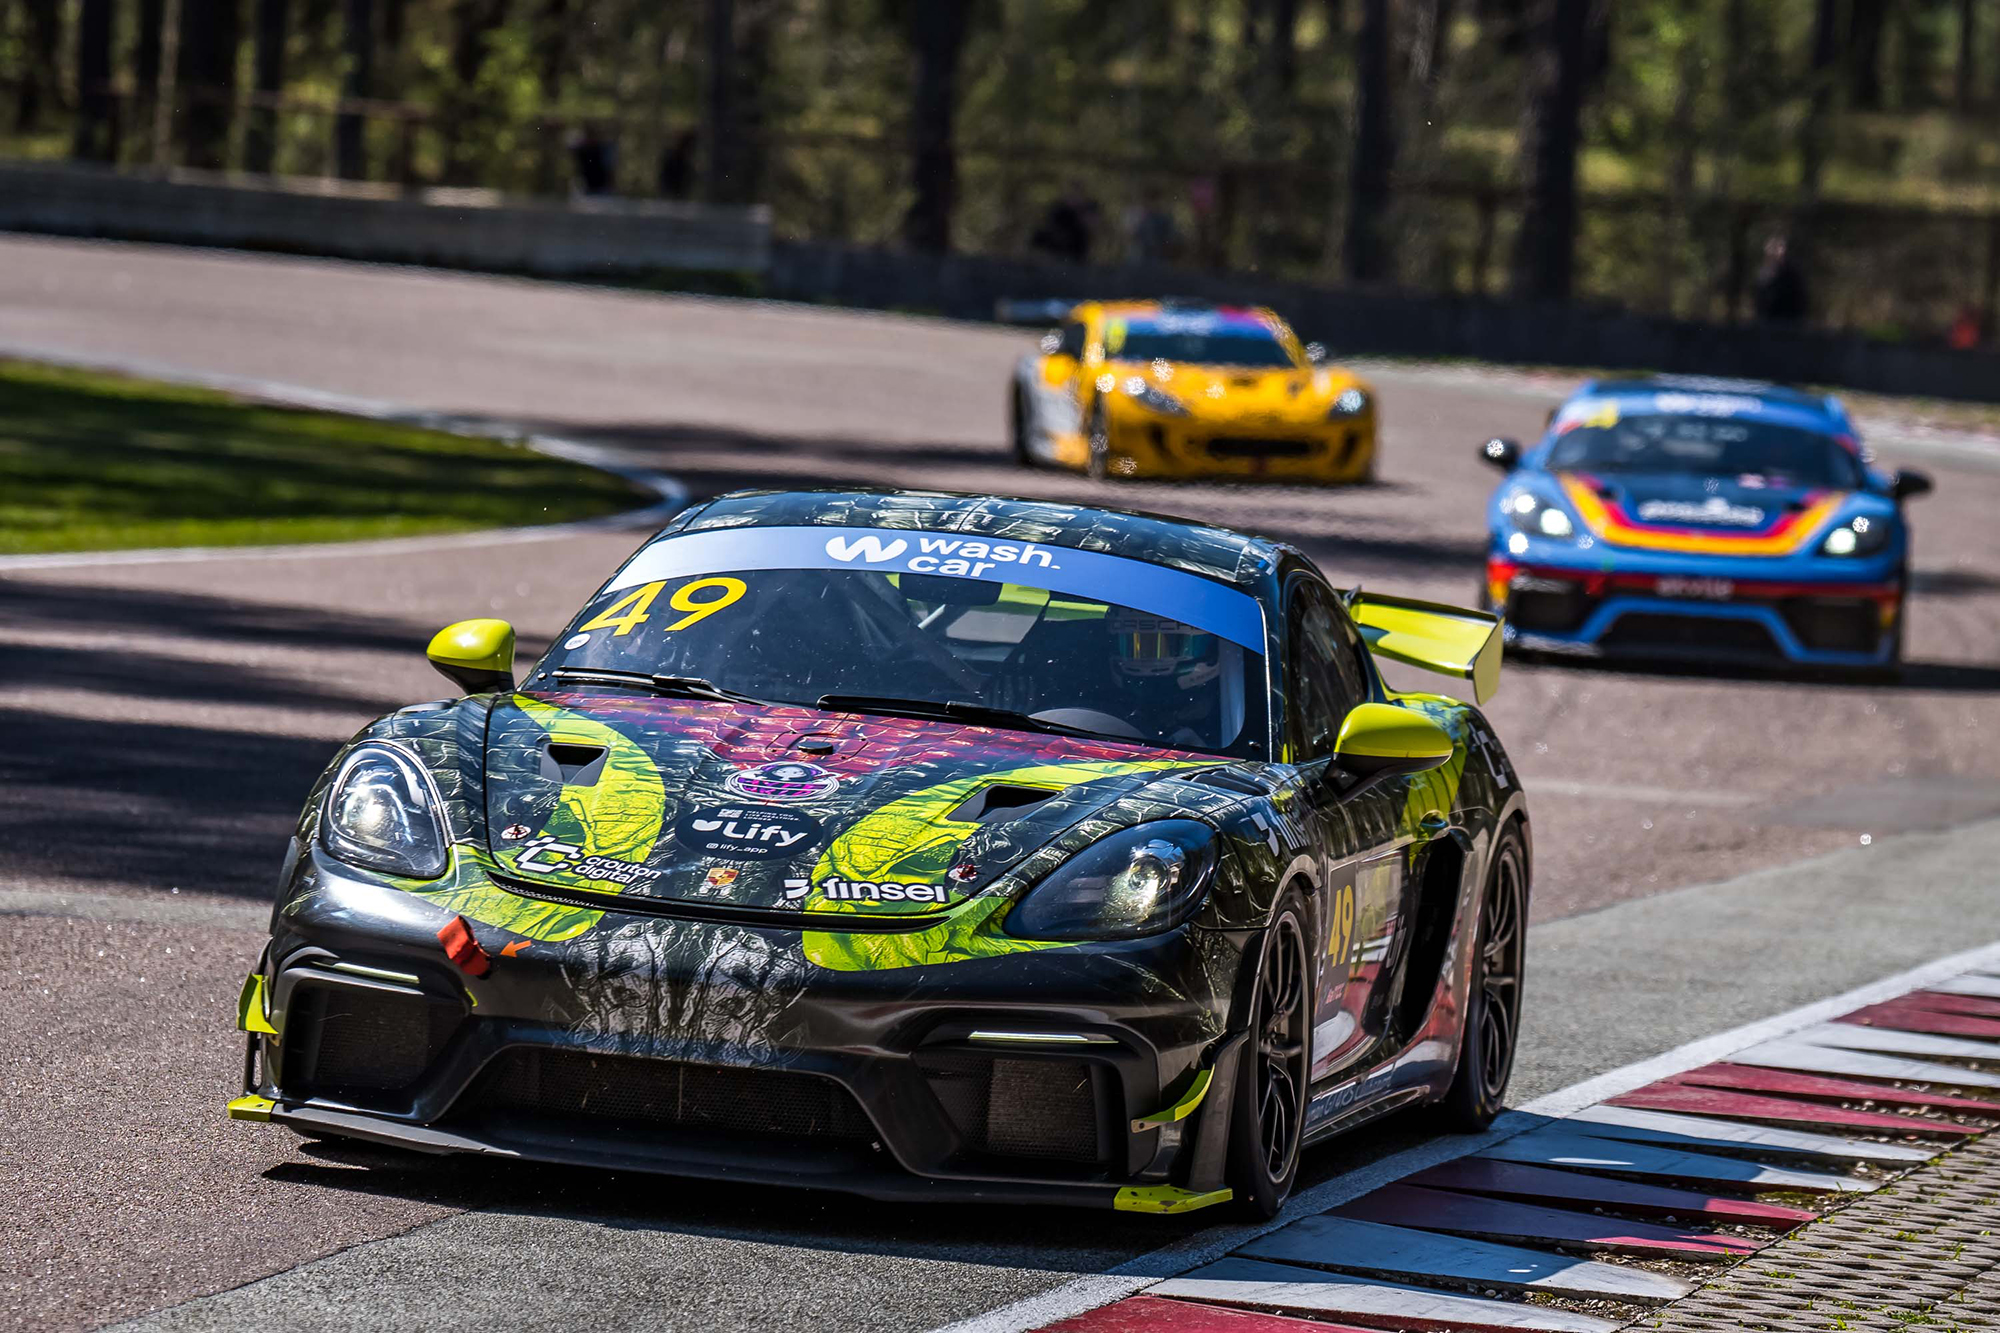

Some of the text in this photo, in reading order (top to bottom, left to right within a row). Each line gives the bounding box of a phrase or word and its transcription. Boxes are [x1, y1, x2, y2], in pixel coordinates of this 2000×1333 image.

[919, 537, 1061, 570] wash.
[907, 556, 996, 577] car
[577, 576, 748, 637] 49
[722, 821, 808, 847] Lify
[720, 843, 768, 854] lify_app
[574, 864, 640, 884] digital
[585, 856, 662, 879] crouton
[1327, 884, 1354, 968] 49
